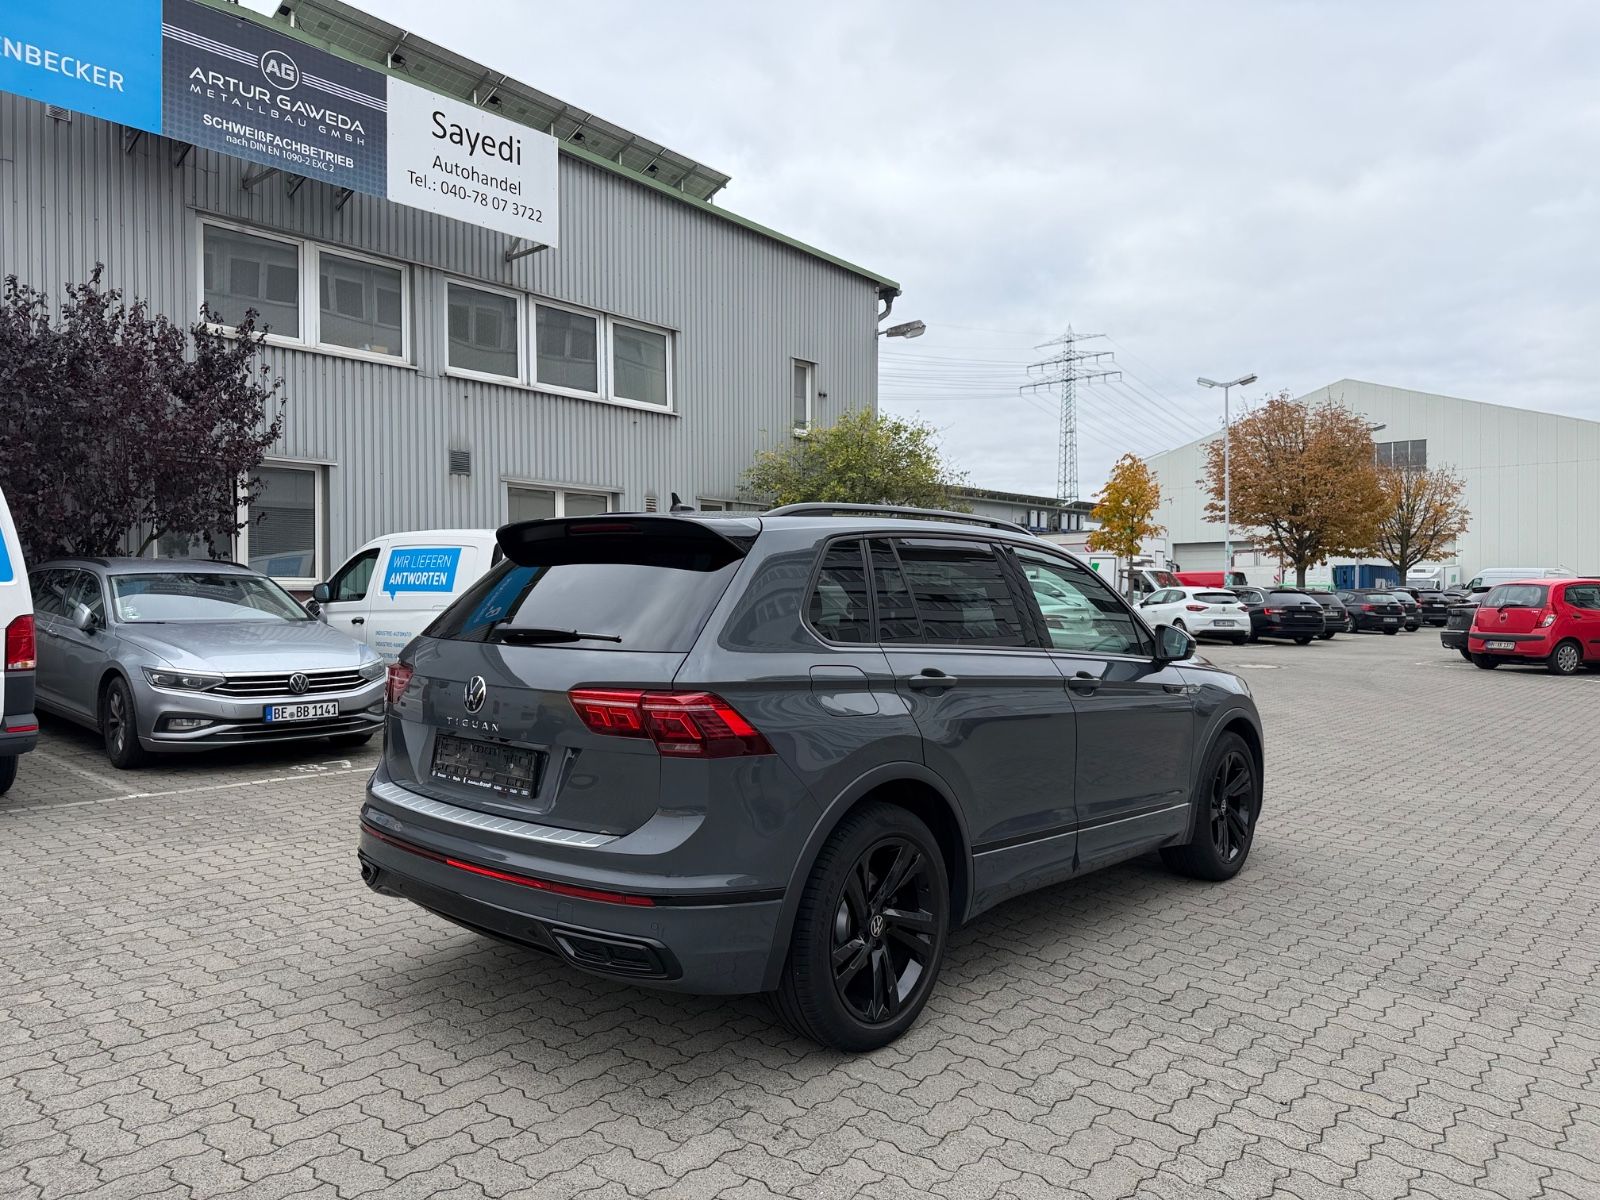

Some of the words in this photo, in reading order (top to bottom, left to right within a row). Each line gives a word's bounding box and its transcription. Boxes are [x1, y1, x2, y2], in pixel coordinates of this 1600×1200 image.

[0, 35, 124, 92] NBECKER
[265, 58, 295, 82] AG
[189, 66, 271, 104] ARTUR
[276, 95, 366, 135] GAWEDA
[190, 83, 307, 127] METALLBAU
[318, 125, 365, 146] GMBH
[203, 113, 354, 168] SCHWEIßFACHBETRIEB
[226, 134, 248, 147] nach
[250, 140, 266, 152] DIN
[268, 145, 280, 156] EN
[312, 159, 328, 171] EXC
[431, 110, 521, 166] Sayedi
[407, 169, 436, 192] Tel.:
[440, 180, 488, 207] 040-78
[492, 196, 508, 212] 07
[512, 202, 543, 223] 3722
[432, 155, 521, 196] Autohandel
[389, 572, 447, 585] ANTWORTEN
[393, 555, 409, 568] WIR
[411, 554, 453, 568] LIEFERN
[273, 707, 288, 719] BE
[296, 705, 310, 718] BB
[312, 703, 337, 717] 1141
[446, 716, 500, 732] TIGUAN
